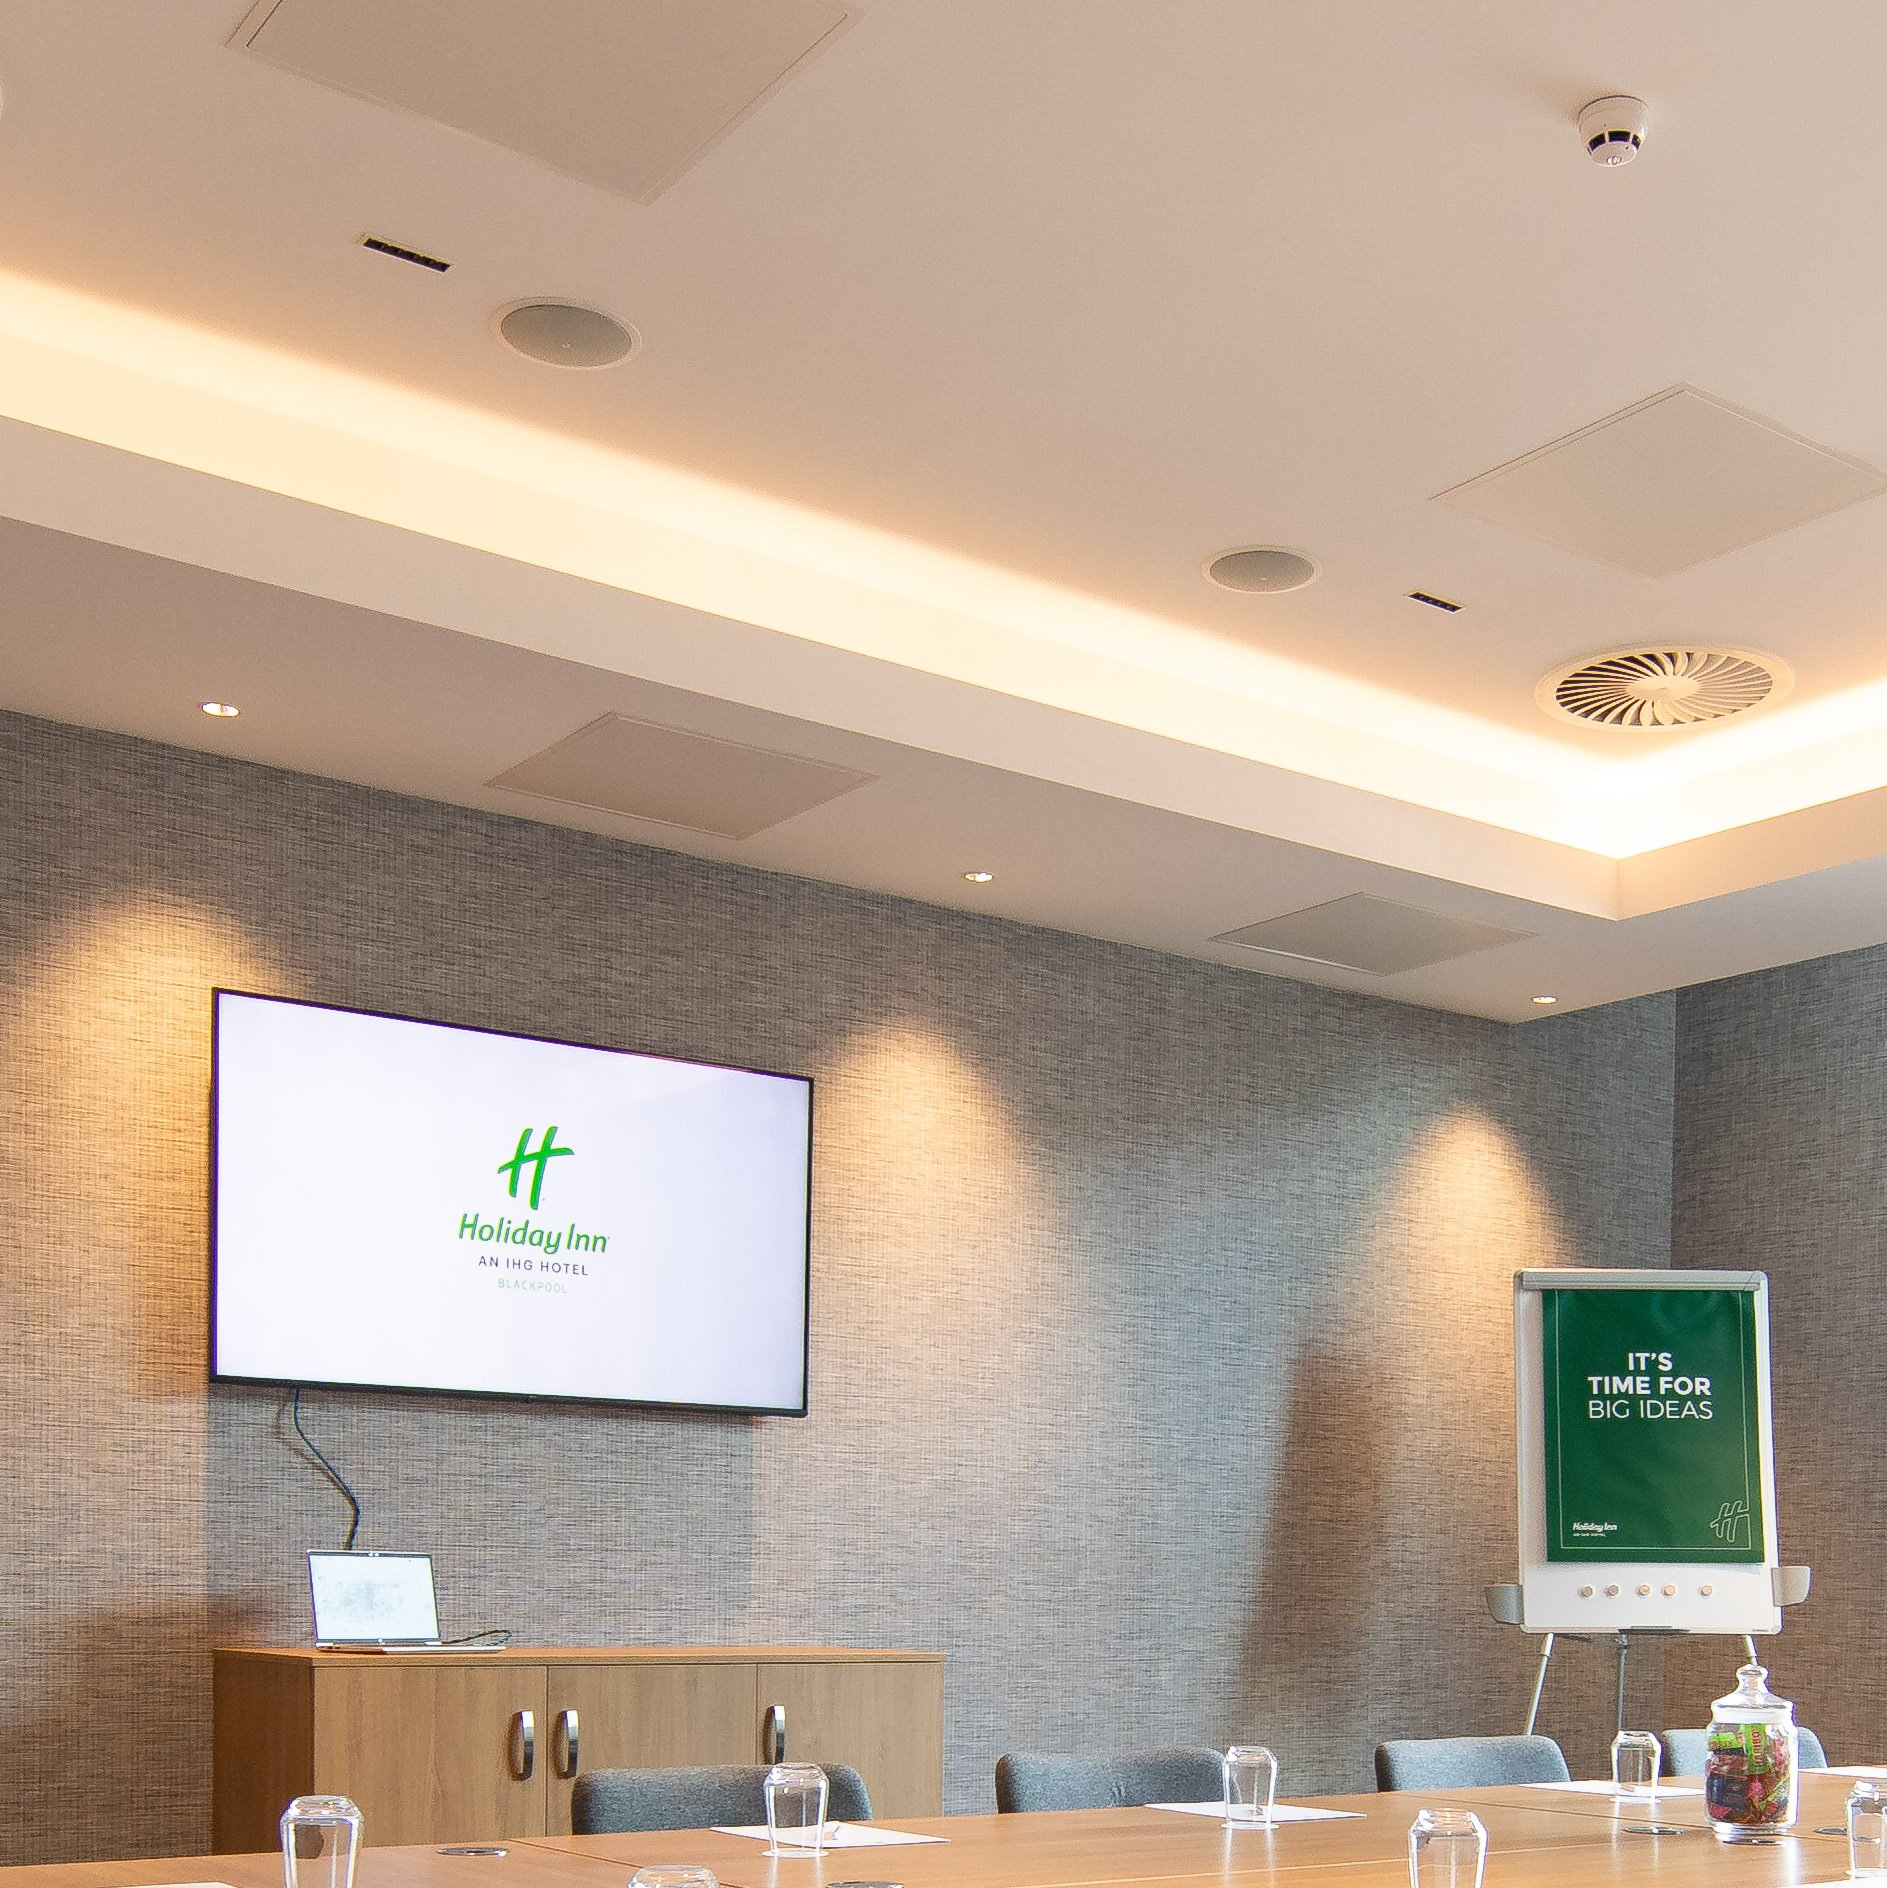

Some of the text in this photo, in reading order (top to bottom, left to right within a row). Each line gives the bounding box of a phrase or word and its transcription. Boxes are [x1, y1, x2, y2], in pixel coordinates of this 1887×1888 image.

[458, 1212, 608, 1255] Holiday Inn
[478, 1256, 588, 1276] AN IHG HOTEL
[498, 1278, 568, 1294] BLACKPOOL
[1587, 1376, 1712, 1395] TIME FOR
[1588, 1399, 1713, 1420] BIG IDEAS
